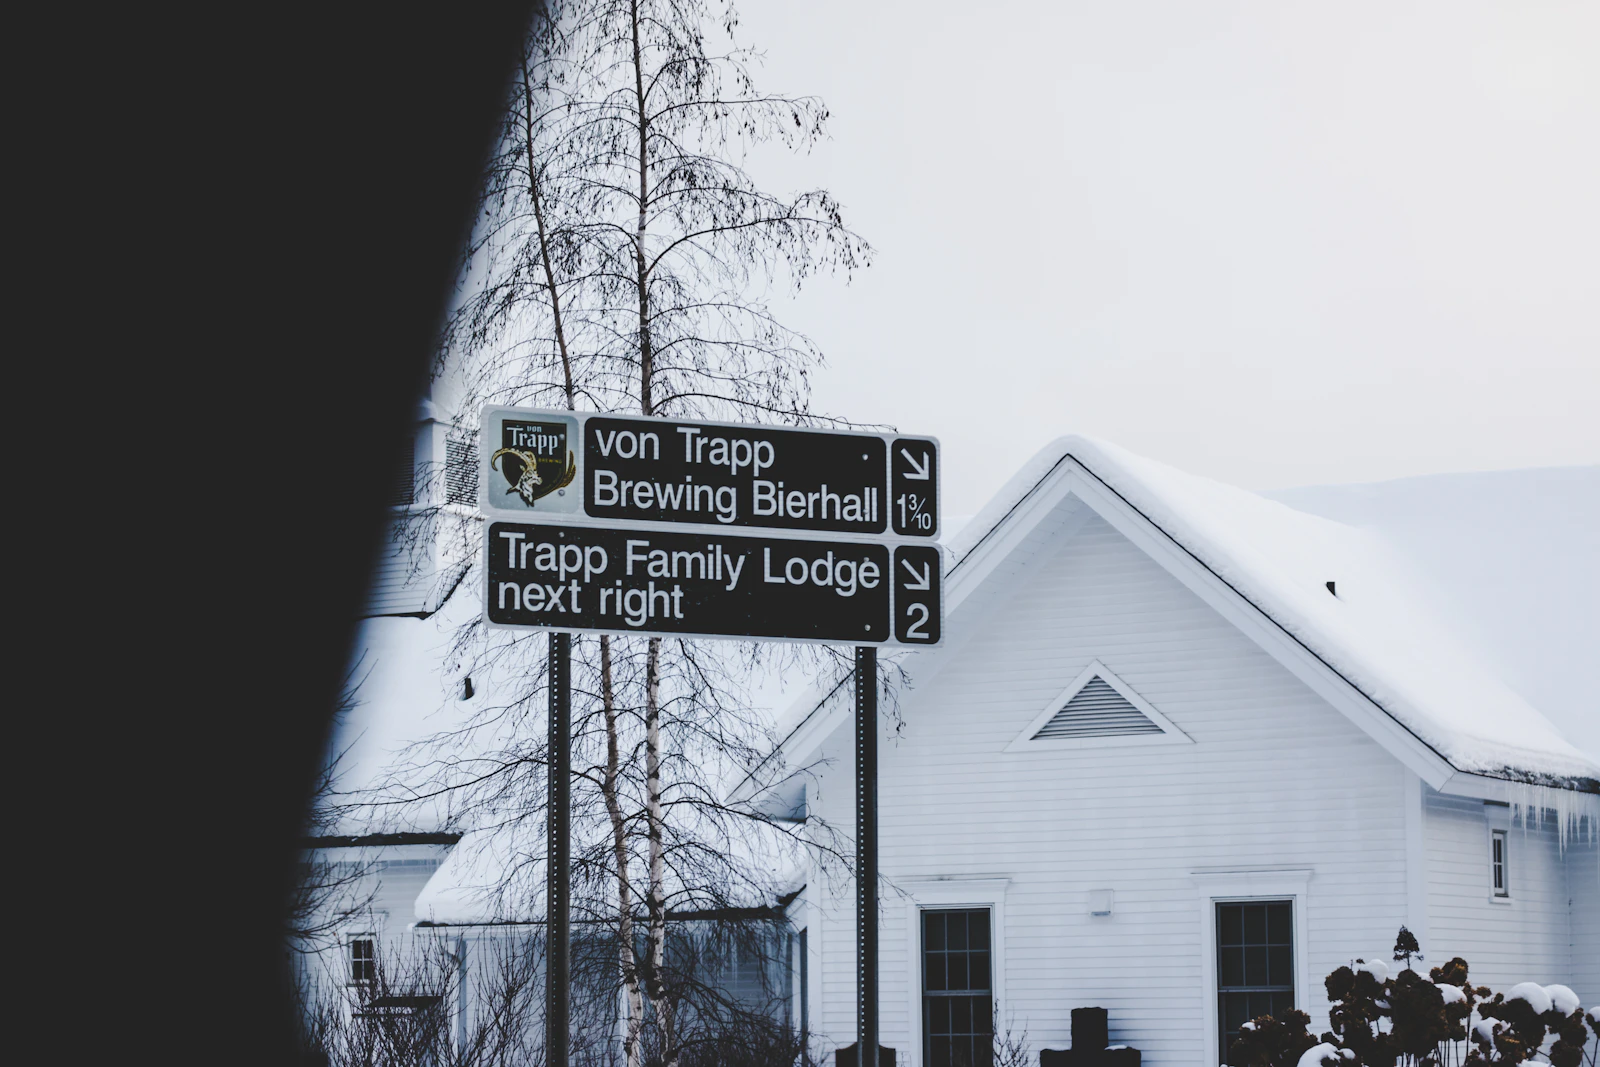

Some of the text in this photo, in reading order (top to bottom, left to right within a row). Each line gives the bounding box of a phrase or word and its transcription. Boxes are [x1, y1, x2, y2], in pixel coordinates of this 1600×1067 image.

[506, 426, 558, 456] Trapp
[526, 425, 542, 433] von
[595, 427, 775, 476] von Trapp
[594, 470, 736, 524] Brewing
[753, 480, 877, 522] Bierhall
[499, 532, 880, 596] Trapp Family Lodge
[499, 580, 683, 626] next right
[906, 602, 930, 639] 2
